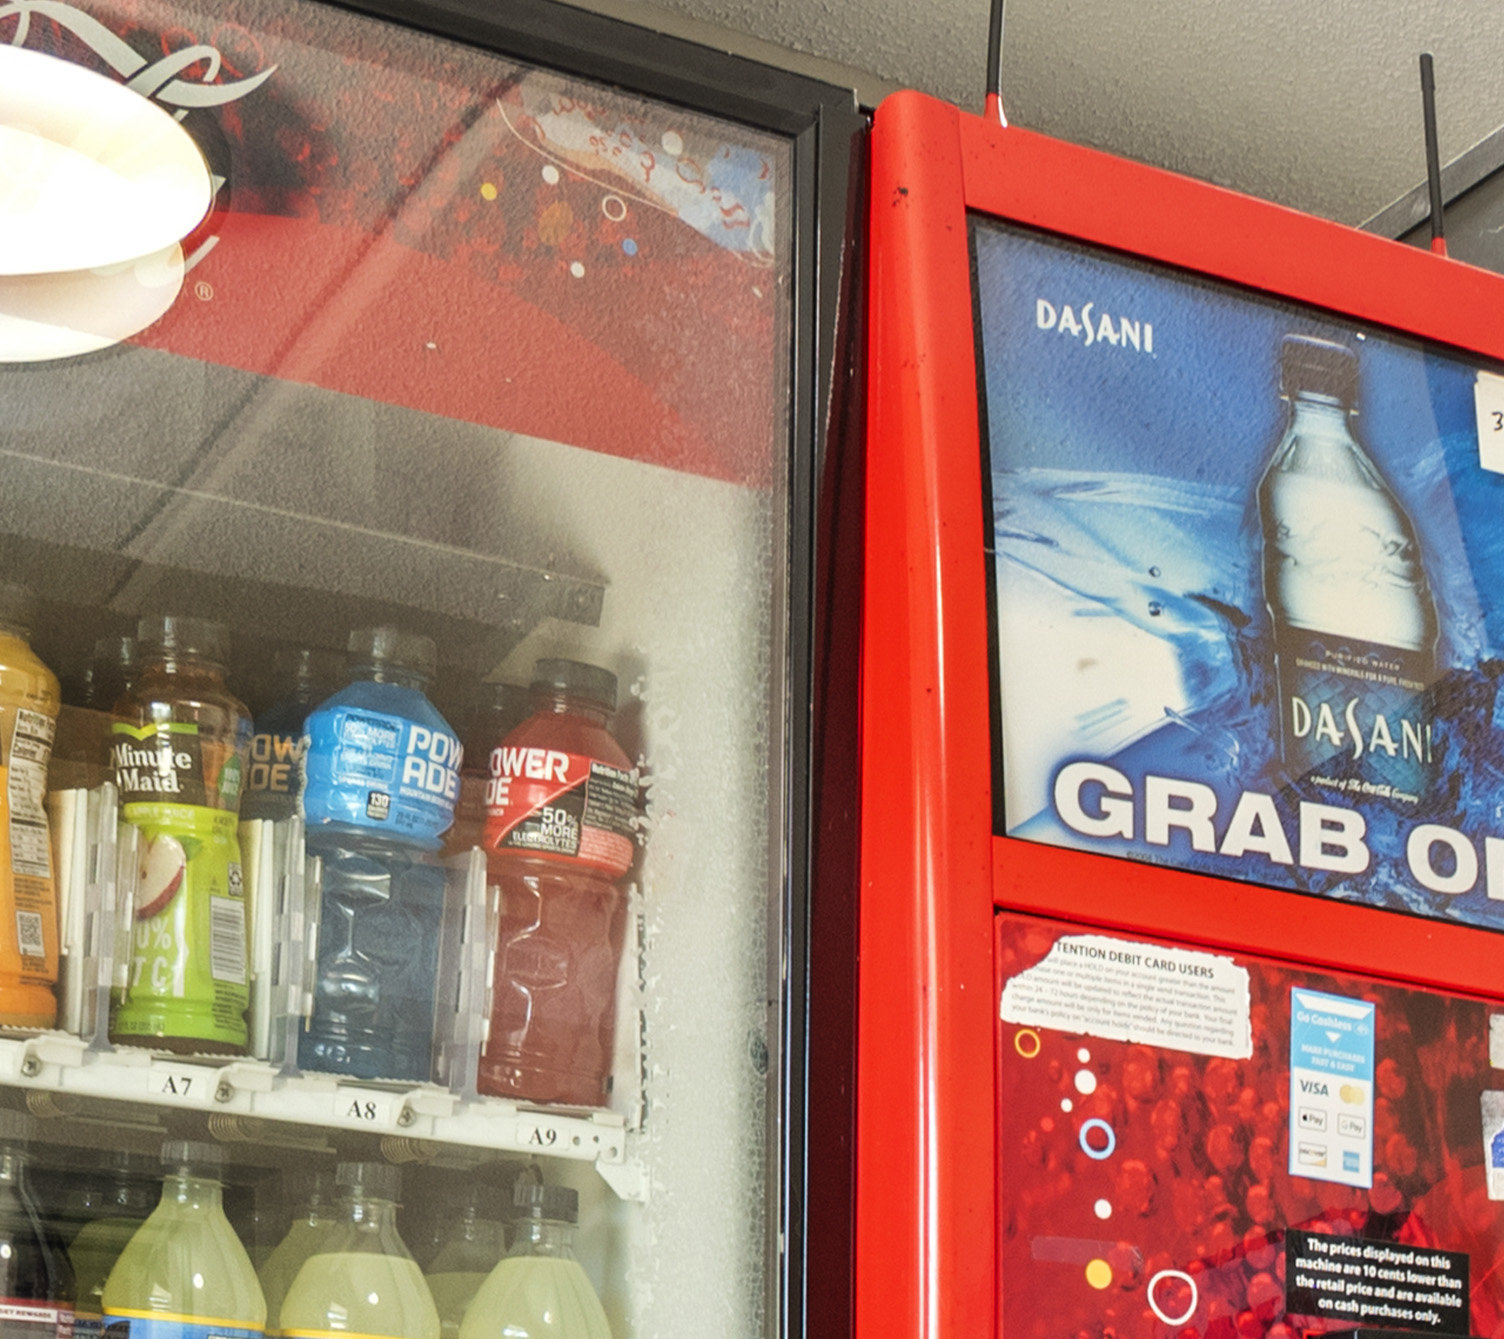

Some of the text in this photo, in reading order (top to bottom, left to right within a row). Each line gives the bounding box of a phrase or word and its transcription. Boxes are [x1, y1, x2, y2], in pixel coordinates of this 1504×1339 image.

[1036, 298, 1154, 354] DASANI
[1292, 696, 1433, 764] DASANI
[1053, 762, 1371, 876] GRAB
[1108, 951, 1141, 967] DEBIT
[1144, 957, 1176, 973] CARD
[1177, 963, 1214, 979] USERS
[1299, 1078, 1330, 1097] VISA
[346, 1099, 377, 1121] A8
[527, 1128, 558, 1148] A9
[1307, 1238, 1451, 1270] The prices displayed on this
[1295, 1257, 1463, 1290] machine are 10 cents lower than
[1295, 1274, 1463, 1308] the retail price and are available
[1318, 1297, 1441, 1326] on cash purchases only.
